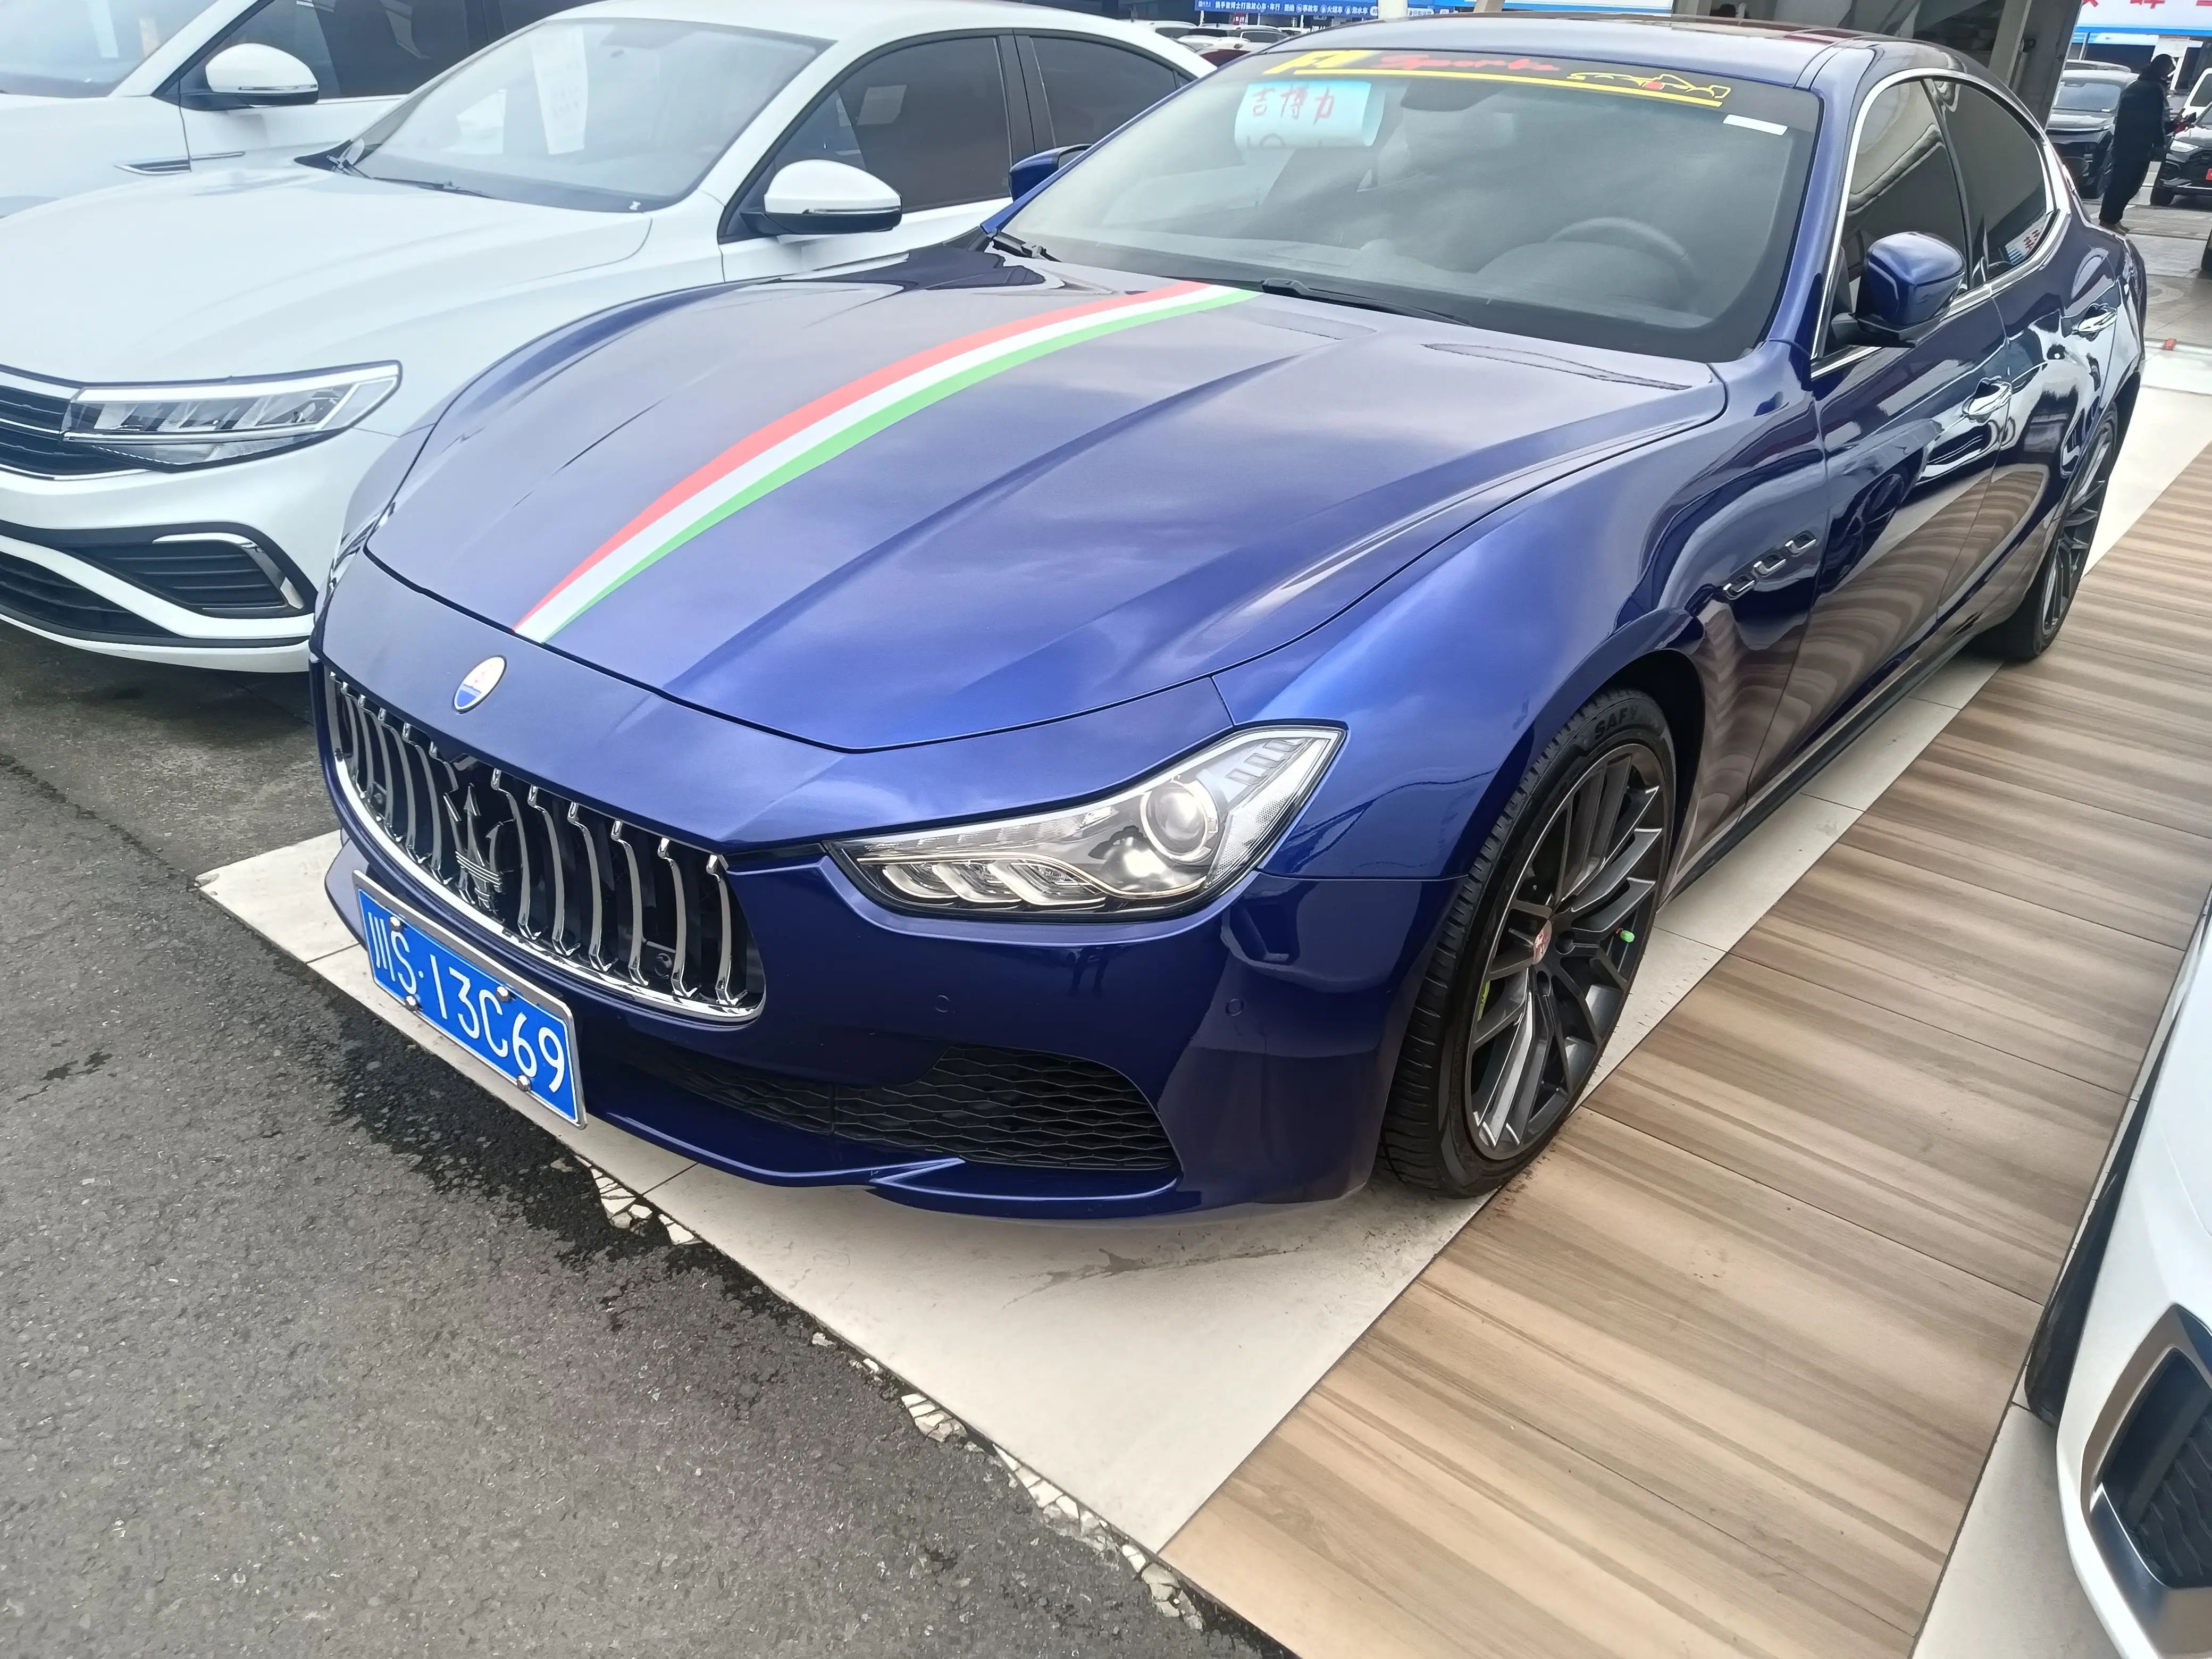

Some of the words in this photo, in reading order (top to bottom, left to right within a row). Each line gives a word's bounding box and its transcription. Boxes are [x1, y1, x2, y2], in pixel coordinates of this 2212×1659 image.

[1252, 84, 1335, 125] 吉博力
[1594, 705, 1639, 740] SAFY
